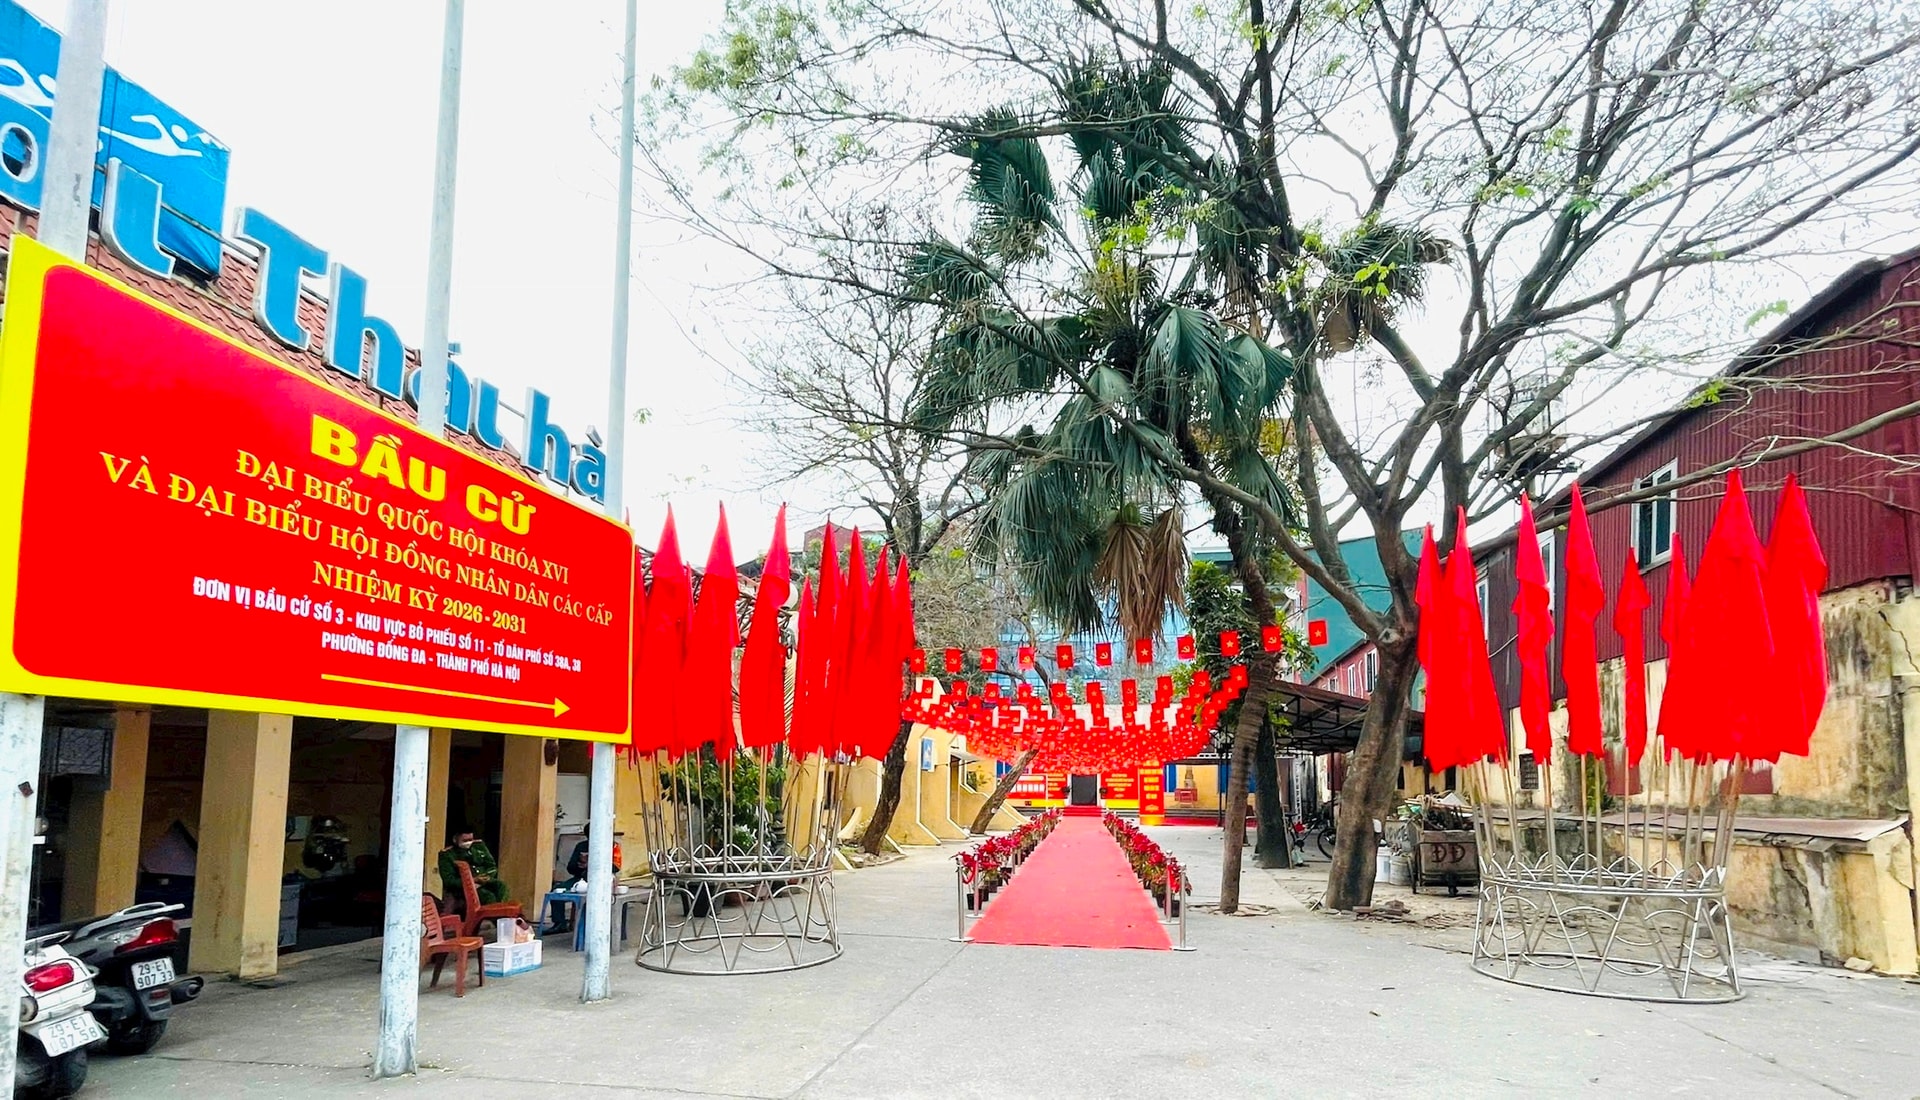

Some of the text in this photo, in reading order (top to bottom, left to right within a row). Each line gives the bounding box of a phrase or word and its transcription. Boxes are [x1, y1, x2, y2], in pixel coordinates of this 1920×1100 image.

[236, 449, 569, 584] ĐẠI BIỂU QUỐC HỘI KHÓA XVI
[310, 413, 537, 535] BẦU CỬ
[99, 451, 613, 626] VÀ ĐẠI BIỂU HỘI ĐỒNG NHÂN DÂN CÁC CẤP
[193, 576, 230, 602] ĐƠN
[235, 585, 250, 609] VỊ
[255, 587, 286, 612] BẦU
[290, 595, 311, 617] CỬ
[313, 600, 332, 623] SỐ
[335, 608, 344, 625] 3
[355, 612, 380, 632] KHU
[384, 618, 406, 638] VỰC
[408, 621, 423, 641] BỎ
[426, 628, 456, 648] PHIẾU
[458, 632, 472, 650] SỐ
[474, 638, 484, 653] 11
[493, 639, 505, 656] TỔ
[506, 644, 523, 661] DÂN
[525, 647, 541, 664] PHỐ
[543, 650, 553, 666] SỐ
[572, 659, 581, 672] 38
[312, 561, 402, 604] NHIỆM
[408, 585, 439, 612] KỲ
[443, 597, 483, 624] 2026
[492, 610, 526, 634] 2031
[322, 631, 374, 656] PHƯỜNG
[377, 638, 409, 662] ĐỐNG
[411, 649, 426, 665] ĐA
[436, 651, 468, 673] THÀNH
[470, 657, 489, 676] PHỐ
[491, 663, 503, 679] HÀ
[505, 664, 520, 683] NỘI
